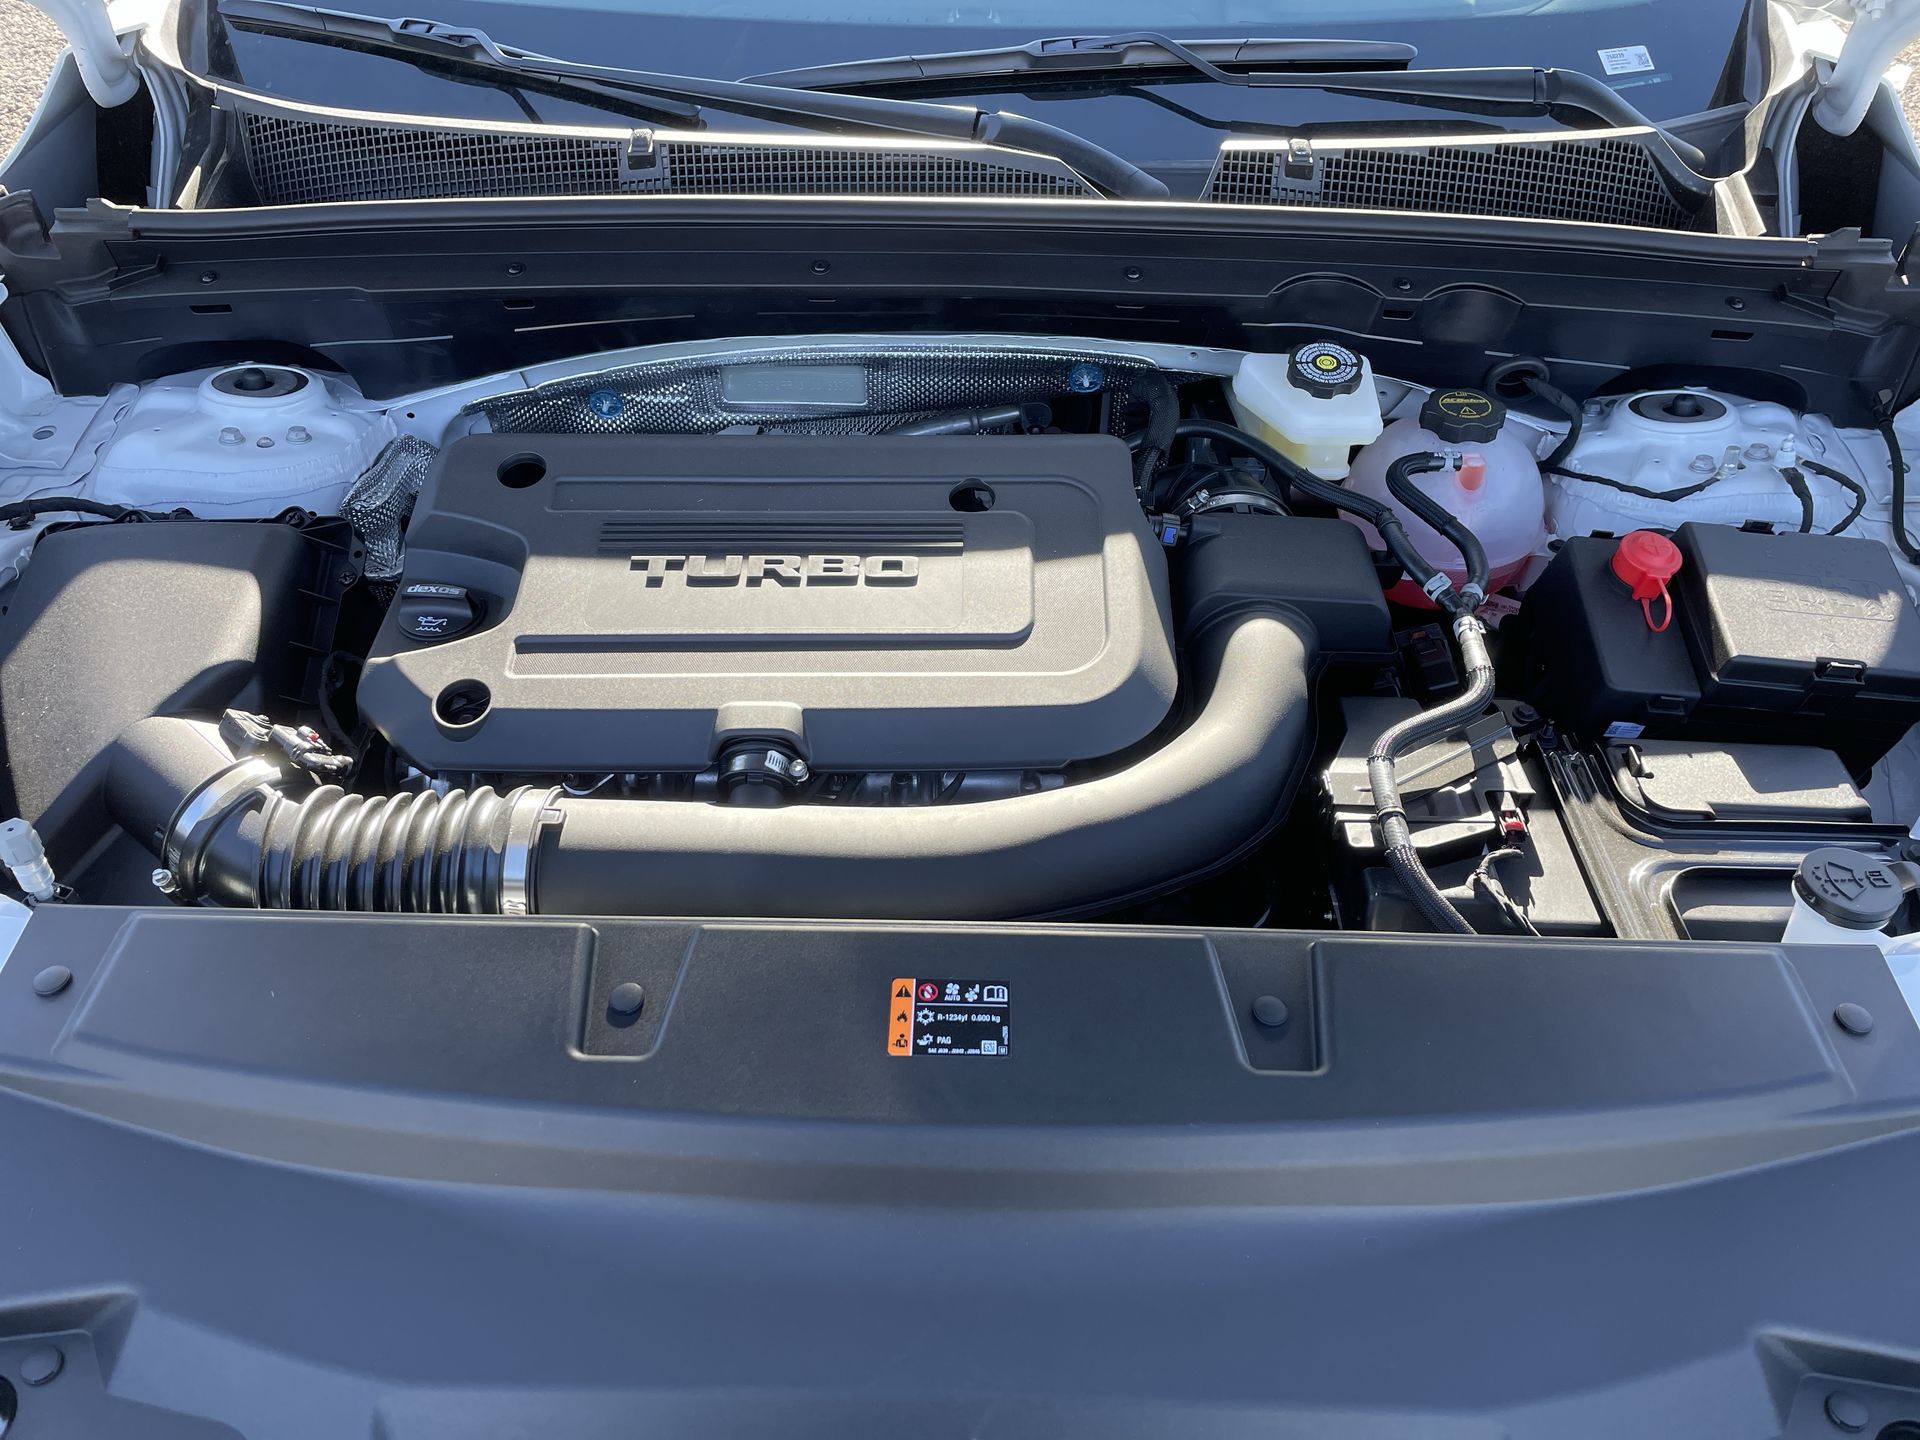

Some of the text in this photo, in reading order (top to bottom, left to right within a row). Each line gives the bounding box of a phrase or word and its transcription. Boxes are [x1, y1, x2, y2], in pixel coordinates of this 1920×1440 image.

[630, 555, 919, 588] TURBO
[406, 584, 461, 595] dexos
[937, 1013, 968, 1022] R-1234yf
[991, 1014, 1001, 1024] kg
[936, 1036, 952, 1044] PAG
